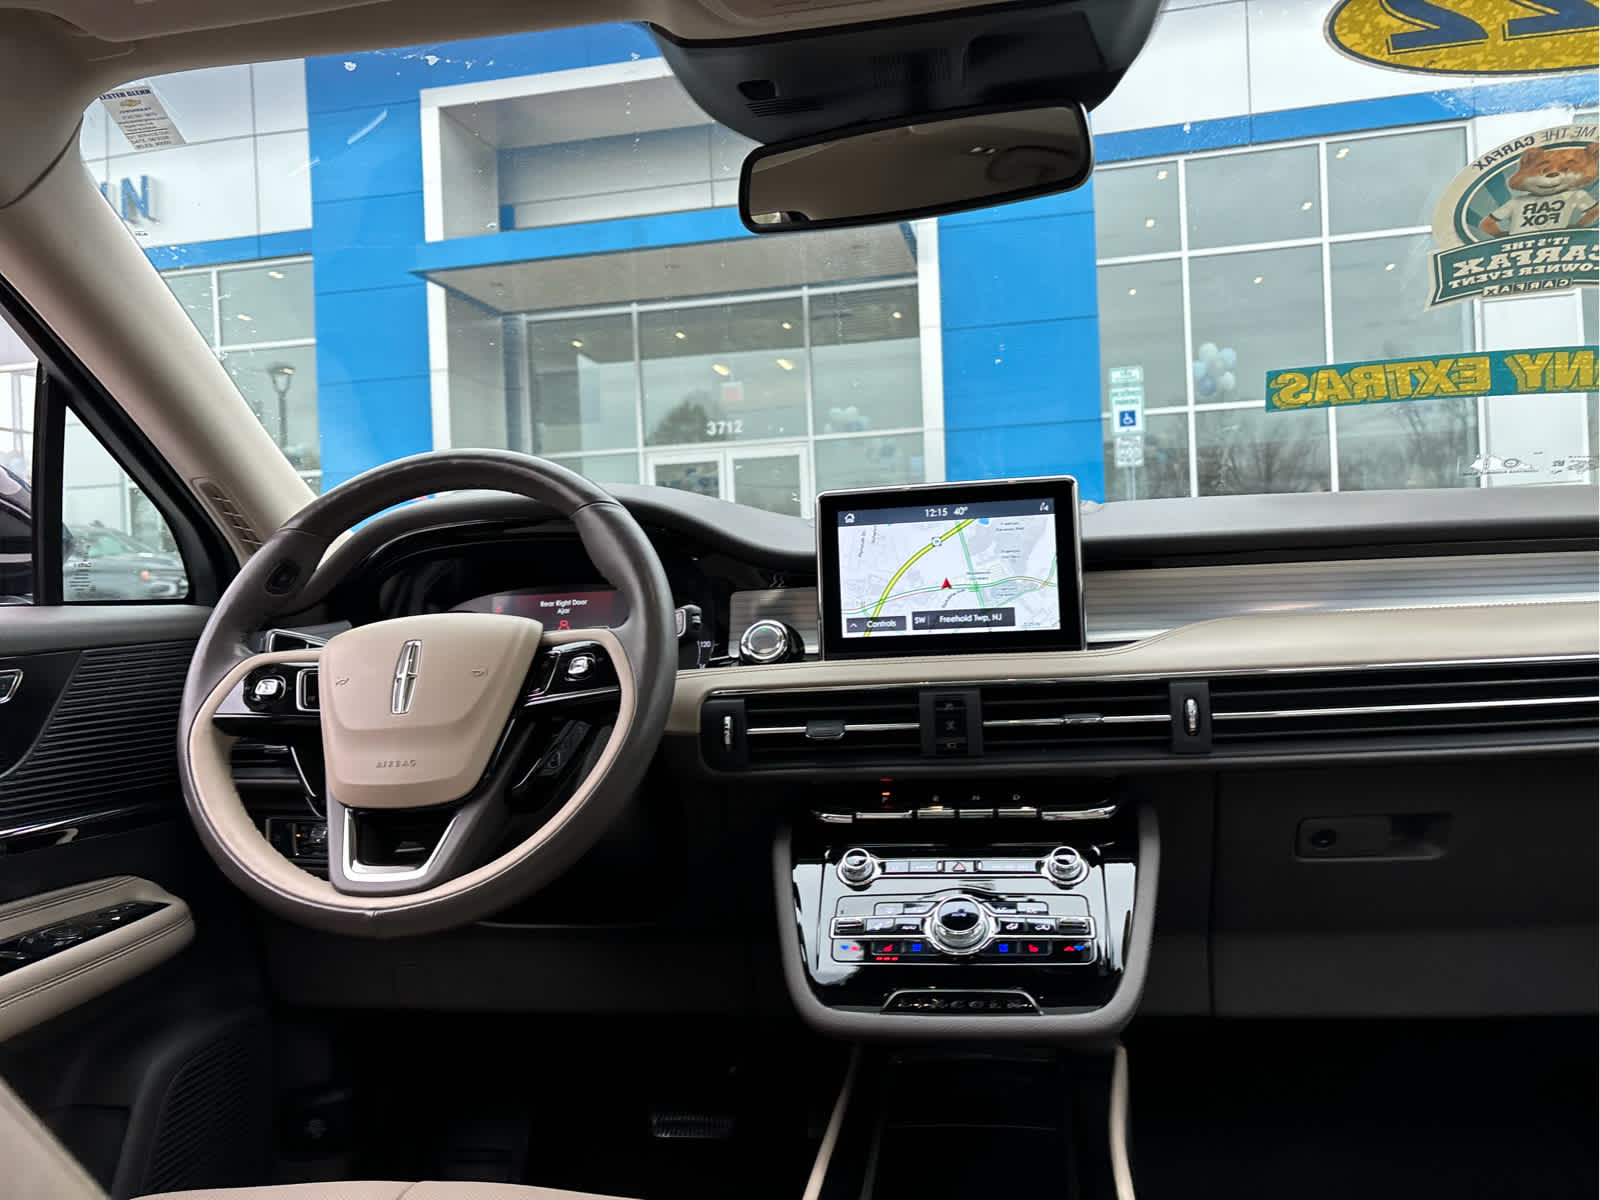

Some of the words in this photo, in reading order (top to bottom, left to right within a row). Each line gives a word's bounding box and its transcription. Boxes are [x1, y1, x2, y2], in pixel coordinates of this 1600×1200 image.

[100, 175, 149, 221] N
[706, 420, 743, 435] 3712
[924, 507, 949, 518] 12:15
[953, 505, 969, 516] 40°
[555, 599, 571, 608] Right
[572, 598, 588, 606] Door
[556, 607, 571, 616] Ajar
[866, 618, 897, 629] Controls
[914, 615, 926, 625] SW
[939, 613, 972, 624] Freehold
[992, 612, 1003, 622] NJ
[375, 759, 417, 769] AIRBAG
